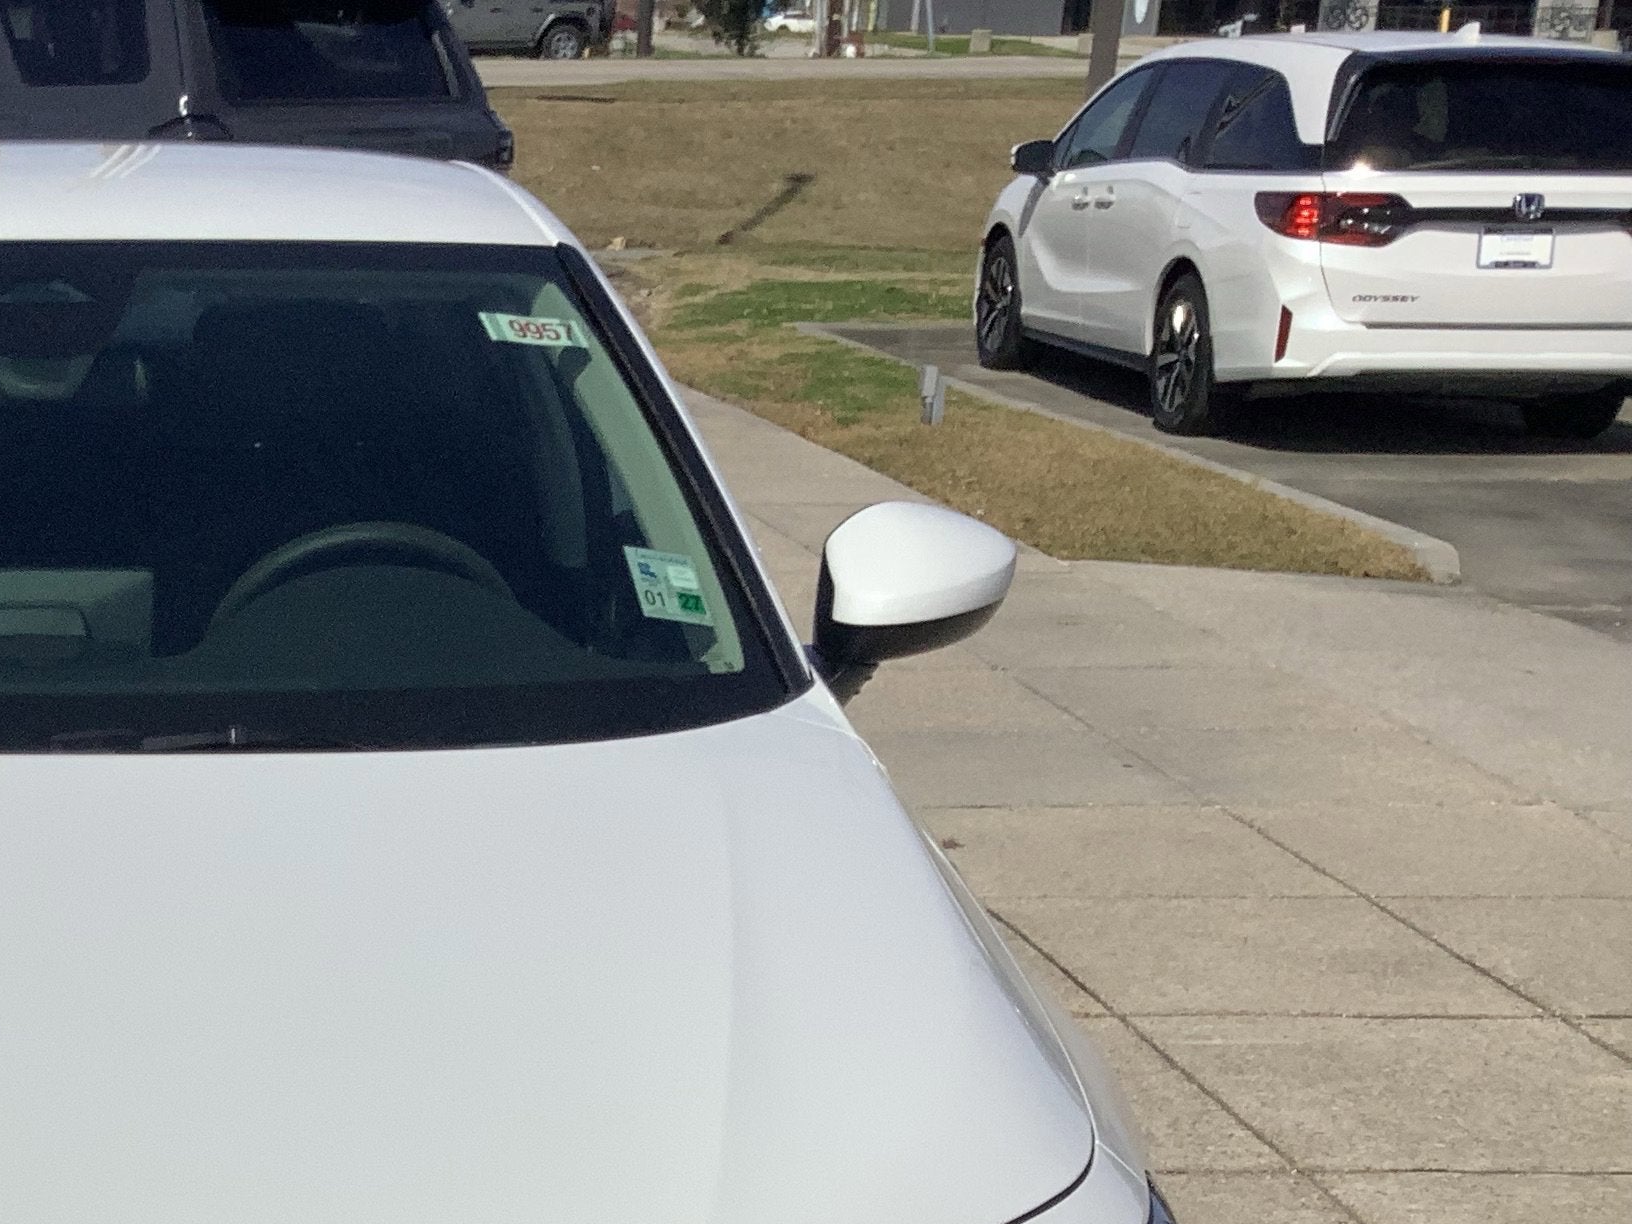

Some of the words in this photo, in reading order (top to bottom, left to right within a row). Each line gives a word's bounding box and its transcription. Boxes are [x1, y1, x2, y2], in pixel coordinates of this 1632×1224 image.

[1351, 294, 1420, 303] ODYSSEY
[508, 319, 572, 340] 9957
[644, 590, 666, 607] 01
